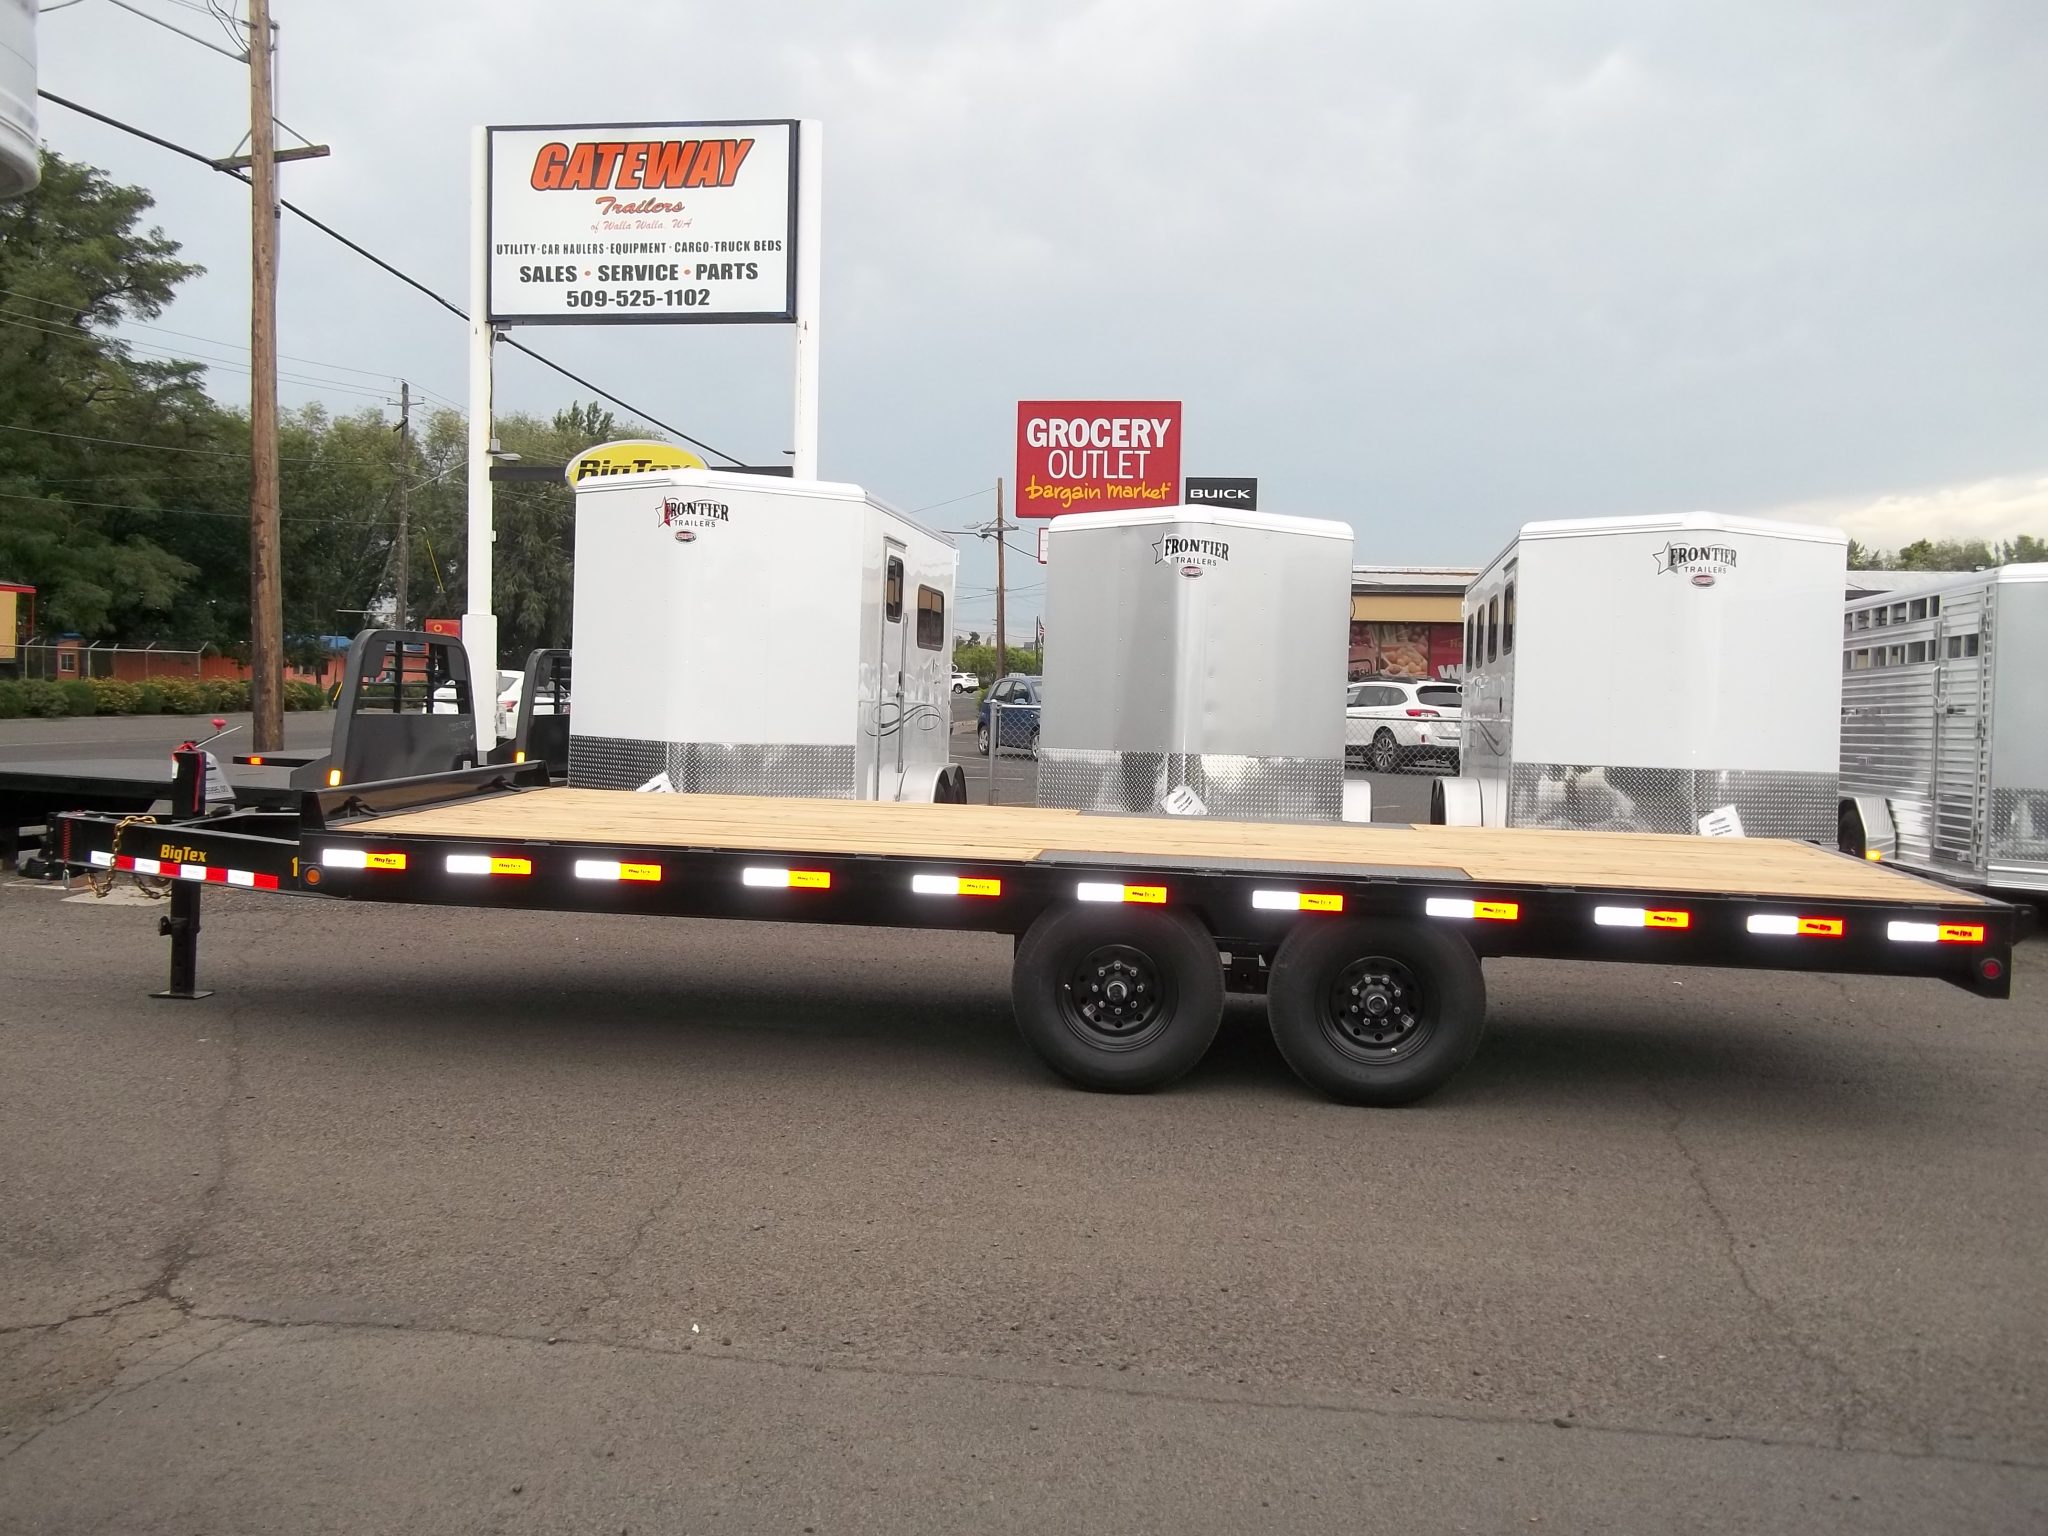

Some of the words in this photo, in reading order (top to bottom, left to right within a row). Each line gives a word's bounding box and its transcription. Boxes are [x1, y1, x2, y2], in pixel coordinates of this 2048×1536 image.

[530, 139, 755, 191] GATEWAY
[595, 196, 685, 216] Trailers
[590, 222, 600, 233] of
[602, 220, 632, 231] Walla
[672, 217, 693, 229] WA
[496, 243, 536, 255] UTILITY
[541, 243, 560, 255] CAR
[563, 243, 604, 255] HAULERS
[610, 242, 666, 255] EQUIPMENT
[674, 241, 709, 253] CARGO
[714, 240, 751, 252] TRUCK
[753, 240, 782, 251] BEDS
[519, 265, 577, 283] SALES
[597, 263, 679, 282] SERVICE
[695, 262, 759, 280] PARTS
[566, 288, 711, 308] 509-525-1102
[1026, 418, 1171, 448] GROCERY
[1048, 449, 1151, 479] OUTLET
[1025, 474, 1101, 508] bargain
[1106, 481, 1171, 500] market
[1190, 489, 1250, 499] BUICK
[664, 501, 730, 521] FRONTIER
[674, 519, 717, 528] TRAILERS
[1164, 538, 1230, 561] FRONTIER
[1670, 546, 1737, 568] FRONTIER
[1175, 556, 1217, 567] TRAILERS
[1684, 566, 1727, 574] TRAILERS
[160, 844, 207, 863] BigTex
